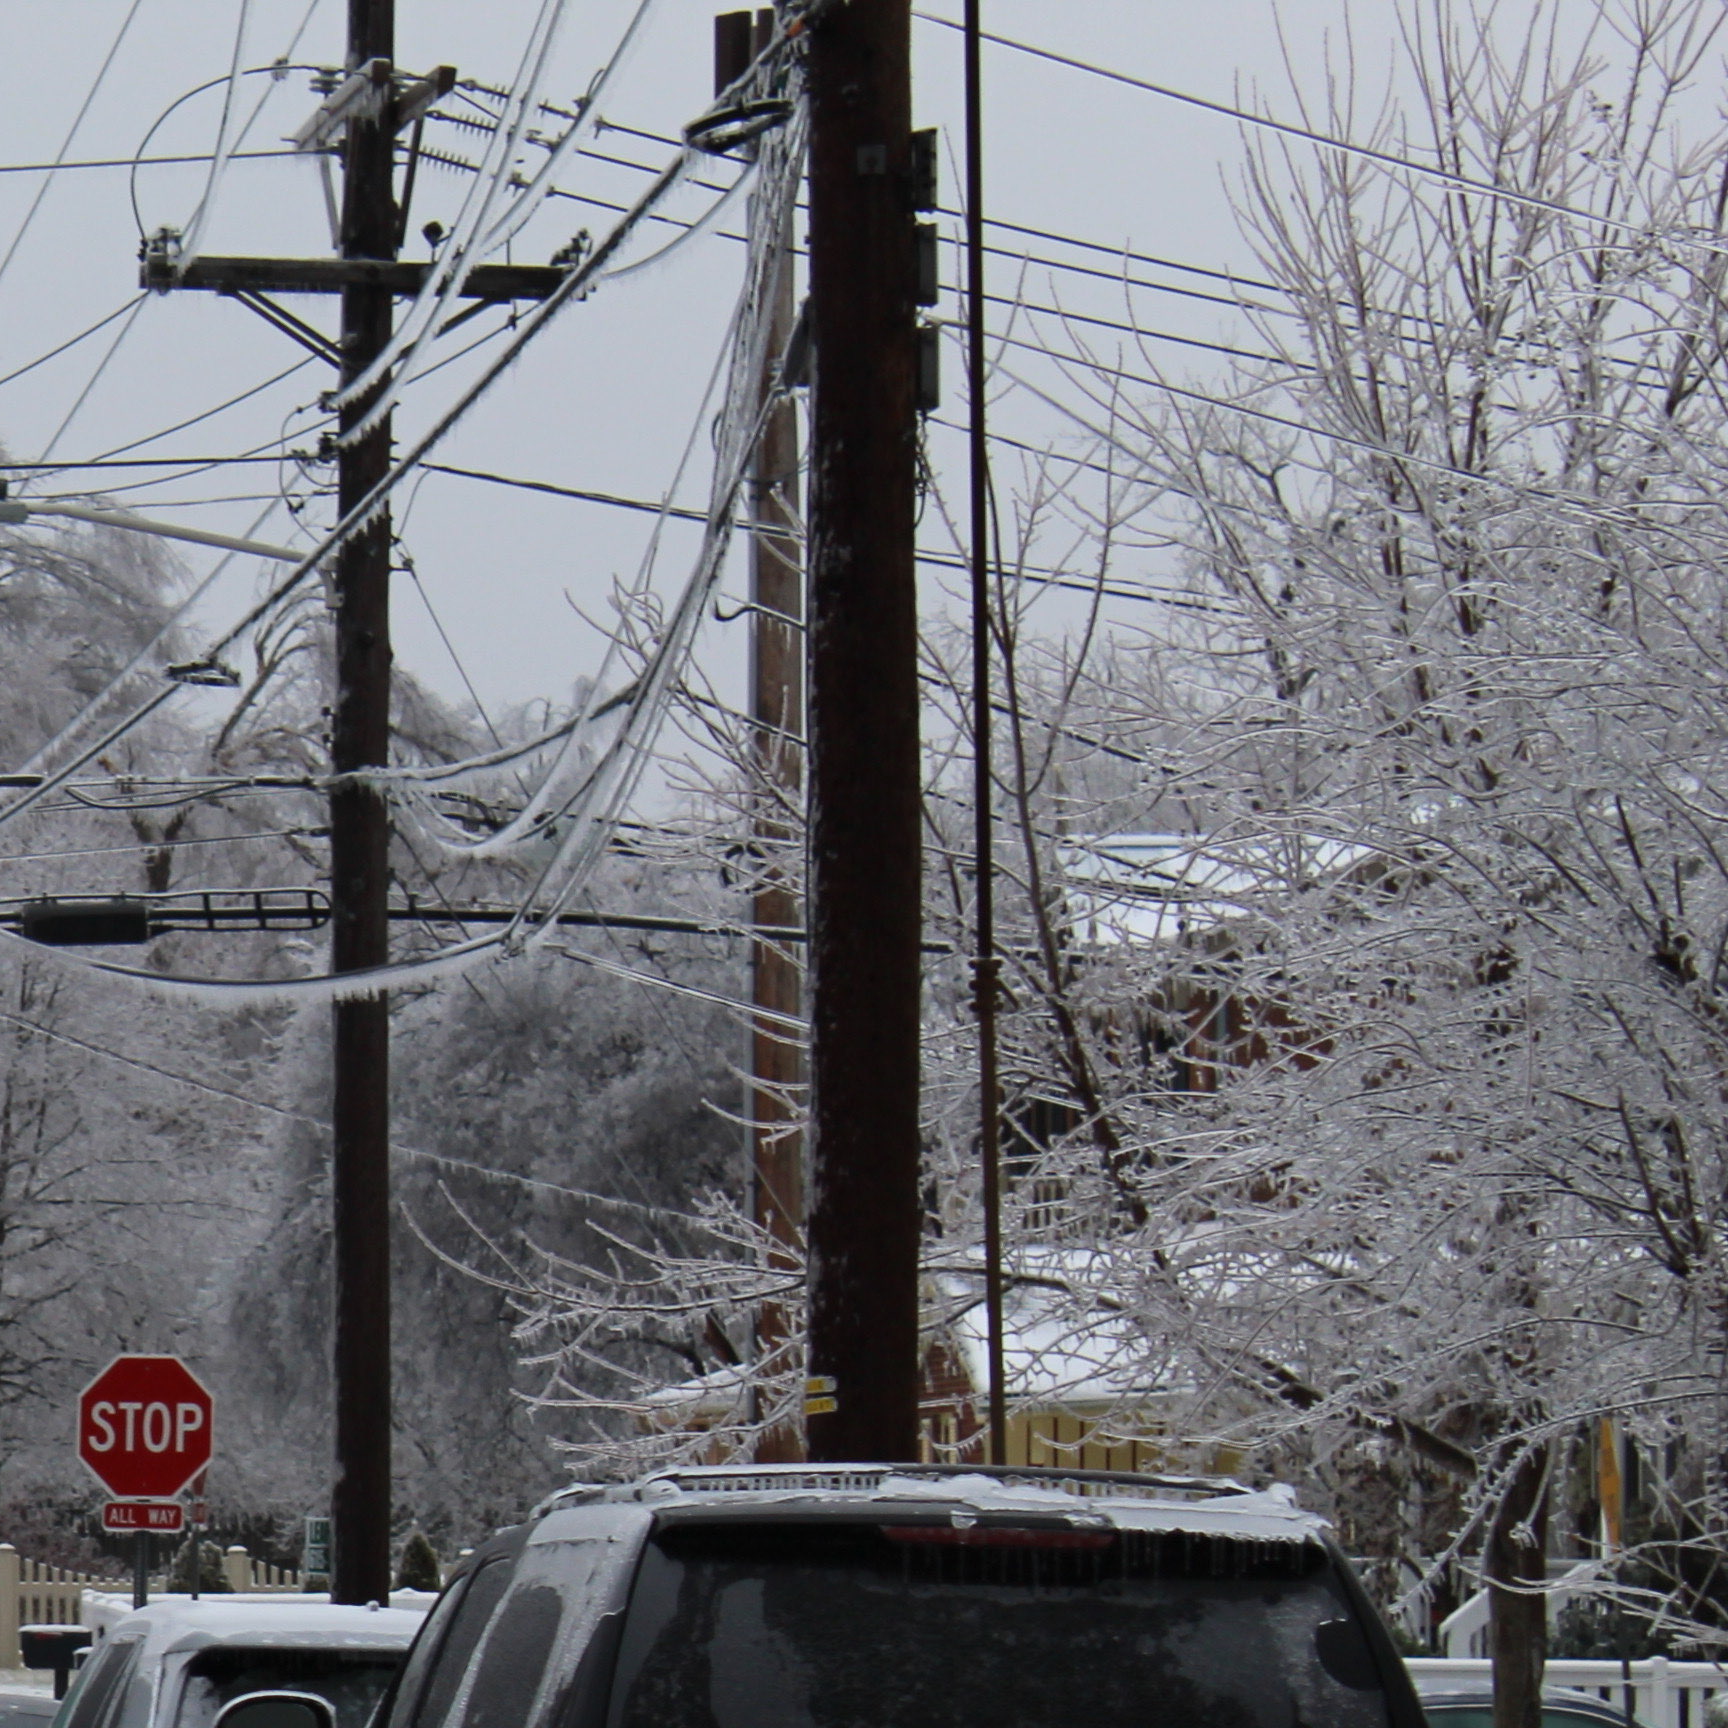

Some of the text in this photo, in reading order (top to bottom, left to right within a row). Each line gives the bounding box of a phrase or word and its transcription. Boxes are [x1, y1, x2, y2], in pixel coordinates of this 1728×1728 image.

[88, 1401, 204, 1453] STOP
[108, 1508, 176, 1525] ALL WAY
